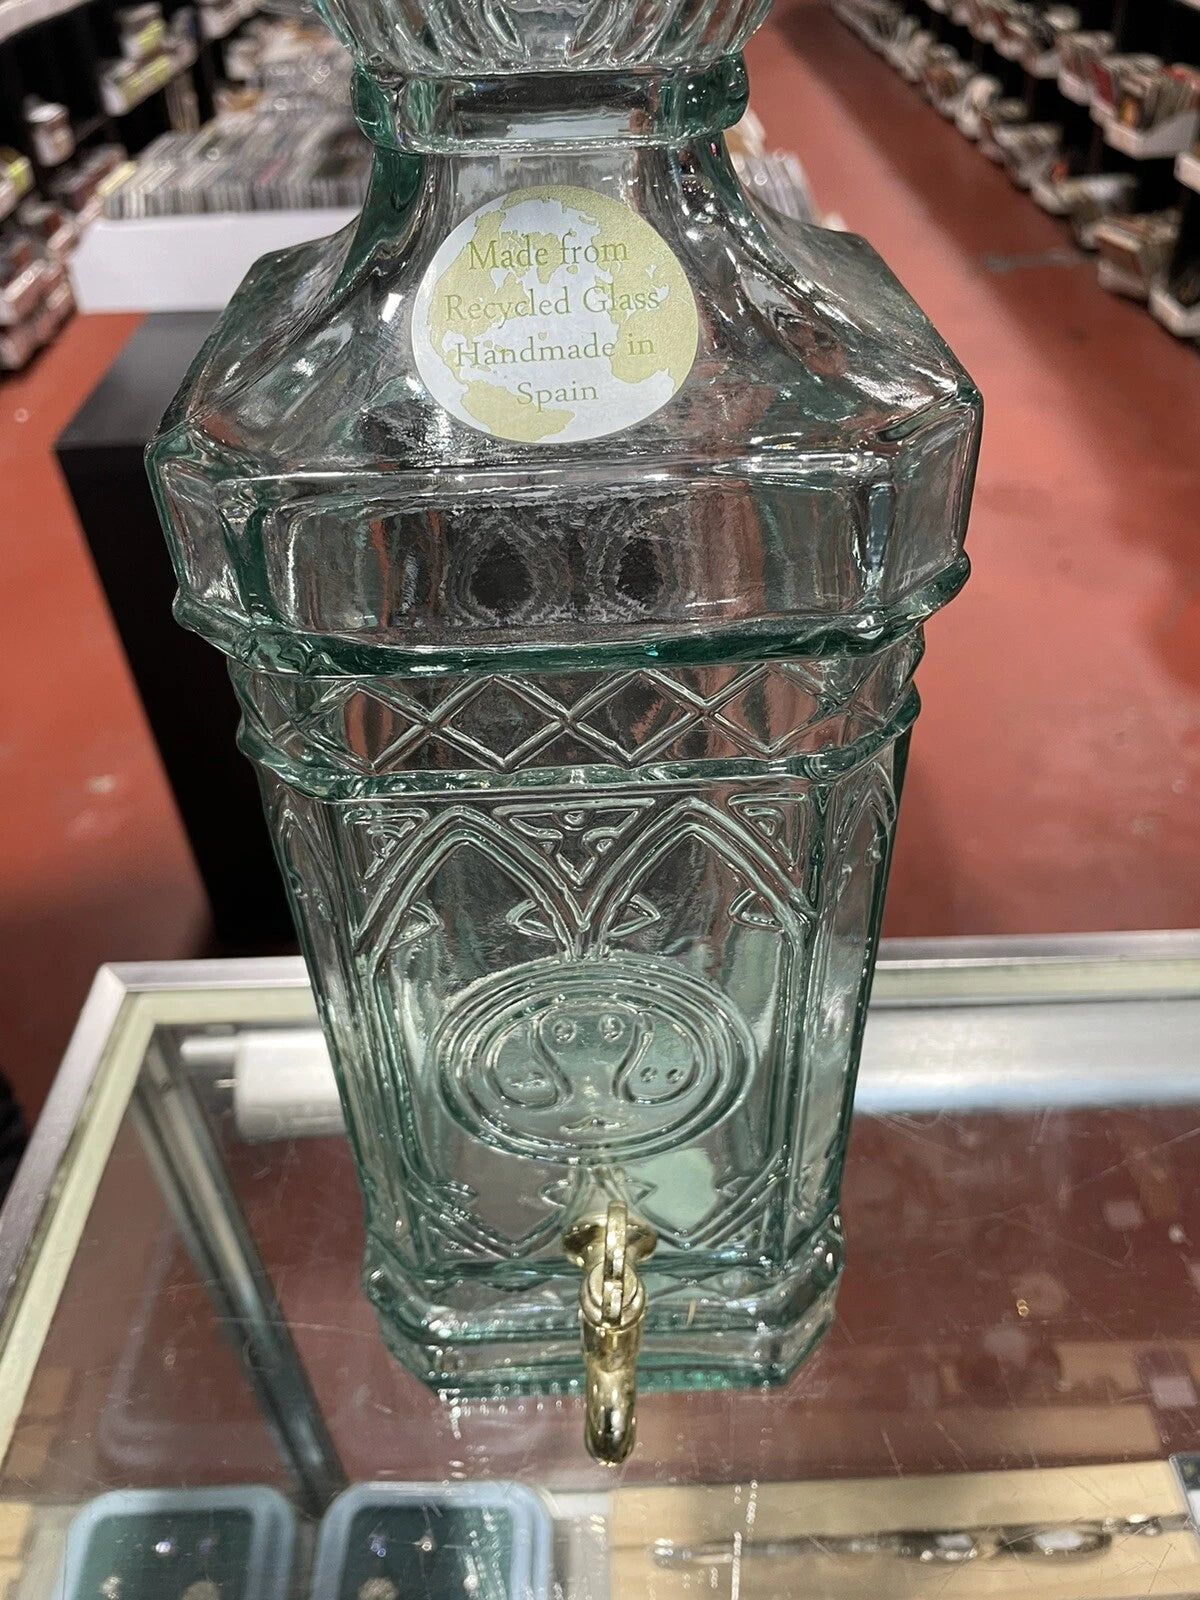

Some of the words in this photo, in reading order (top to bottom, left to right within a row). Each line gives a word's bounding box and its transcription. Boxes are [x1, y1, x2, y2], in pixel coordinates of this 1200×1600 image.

[468, 235, 549, 270] Made
[561, 231, 630, 264] from
[444, 286, 572, 329] Recycled
[583, 283, 661, 314] Glass
[455, 332, 616, 368] Handmade
[627, 333, 657, 357] in
[516, 381, 600, 413] Spain
